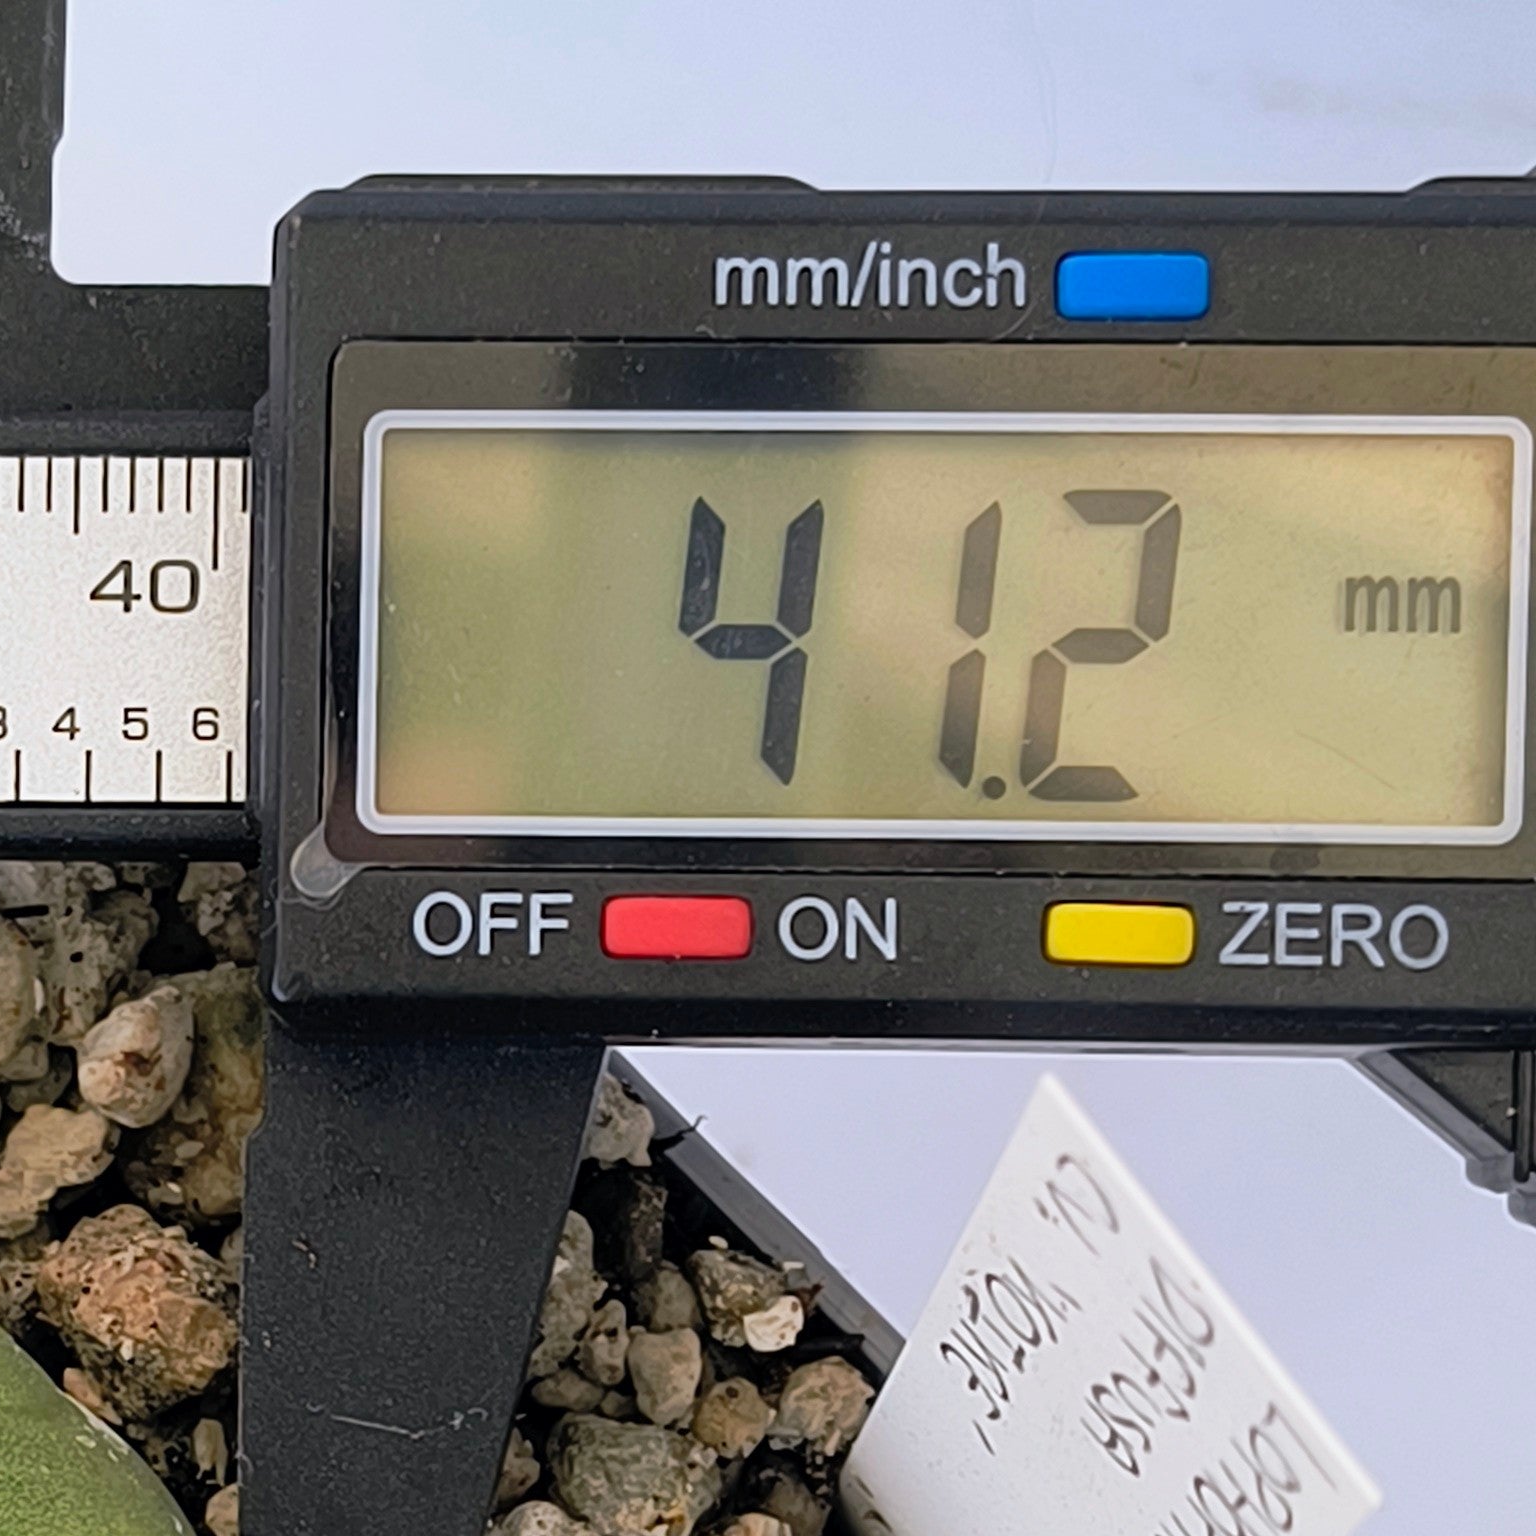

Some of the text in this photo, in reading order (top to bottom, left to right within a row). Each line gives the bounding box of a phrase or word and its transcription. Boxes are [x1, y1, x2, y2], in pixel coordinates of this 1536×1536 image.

[716, 241, 1026, 310] mm/inch
[89, 558, 200, 615] 40
[678, 488, 1463, 804] 41.2 mm
[51, 706, 80, 741] 4
[122, 706, 149, 741] 5
[192, 706, 219, 741] 6
[413, 891, 574, 957] OFF
[779, 896, 898, 962] ON
[1219, 900, 1449, 970] ZERO
[1080, 1256, 1215, 1478] DIFFUSA
